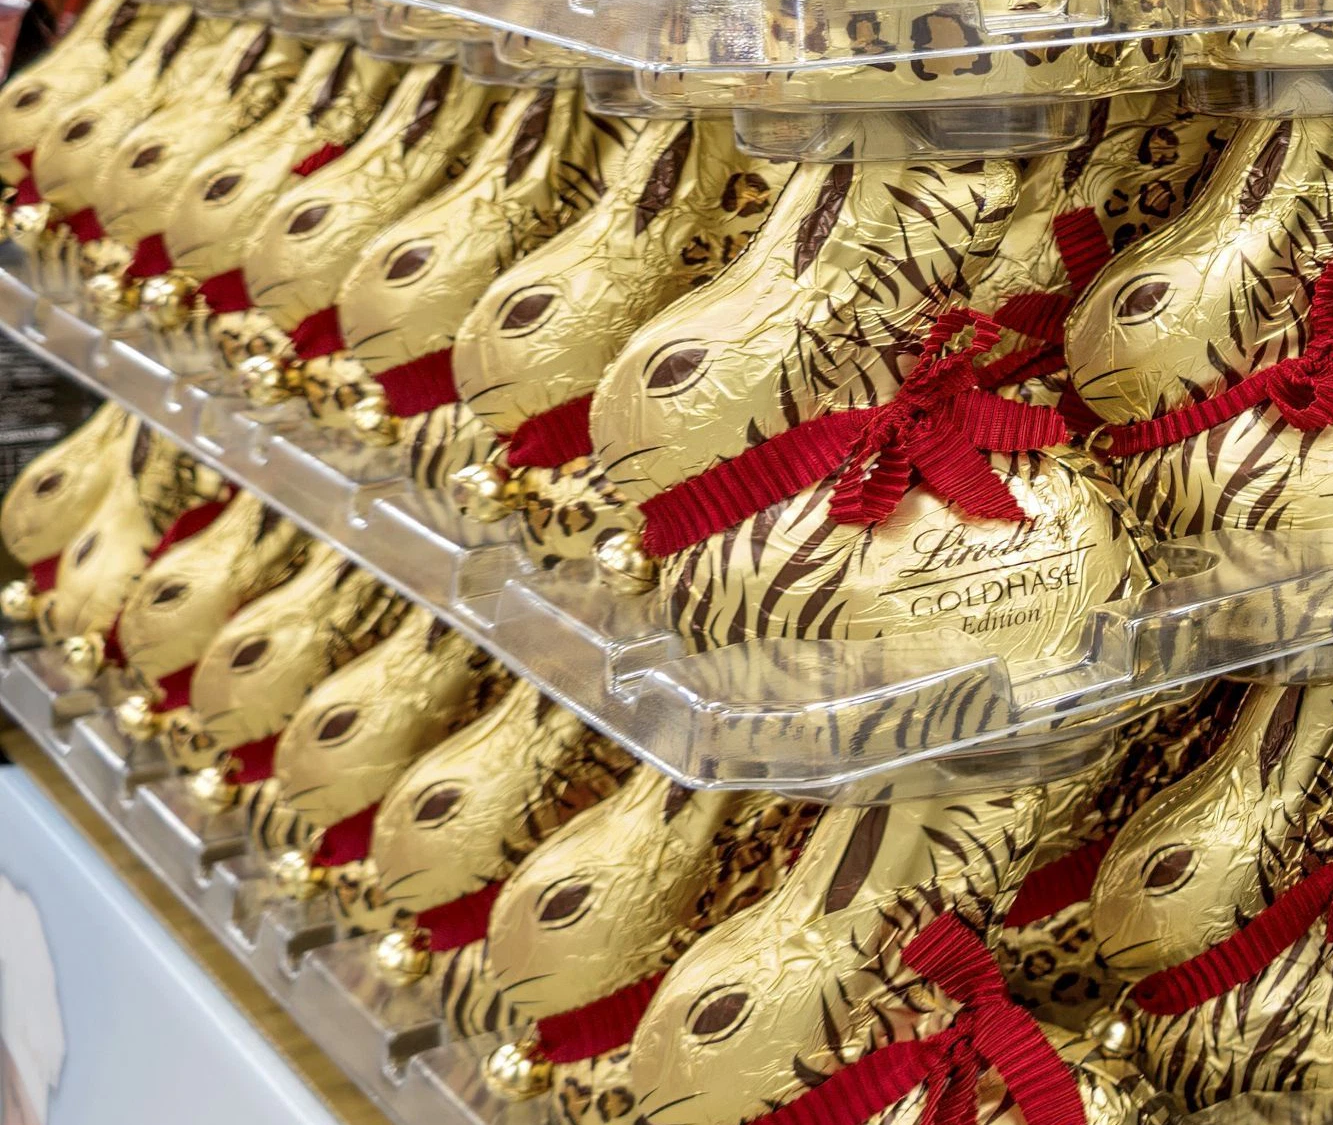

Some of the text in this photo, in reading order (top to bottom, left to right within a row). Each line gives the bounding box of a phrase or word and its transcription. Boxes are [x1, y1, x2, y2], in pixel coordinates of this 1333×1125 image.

[899, 515, 1044, 578] Lindt
[910, 562, 1079, 618] GOLDHASE
[961, 607, 1042, 636] Edition
